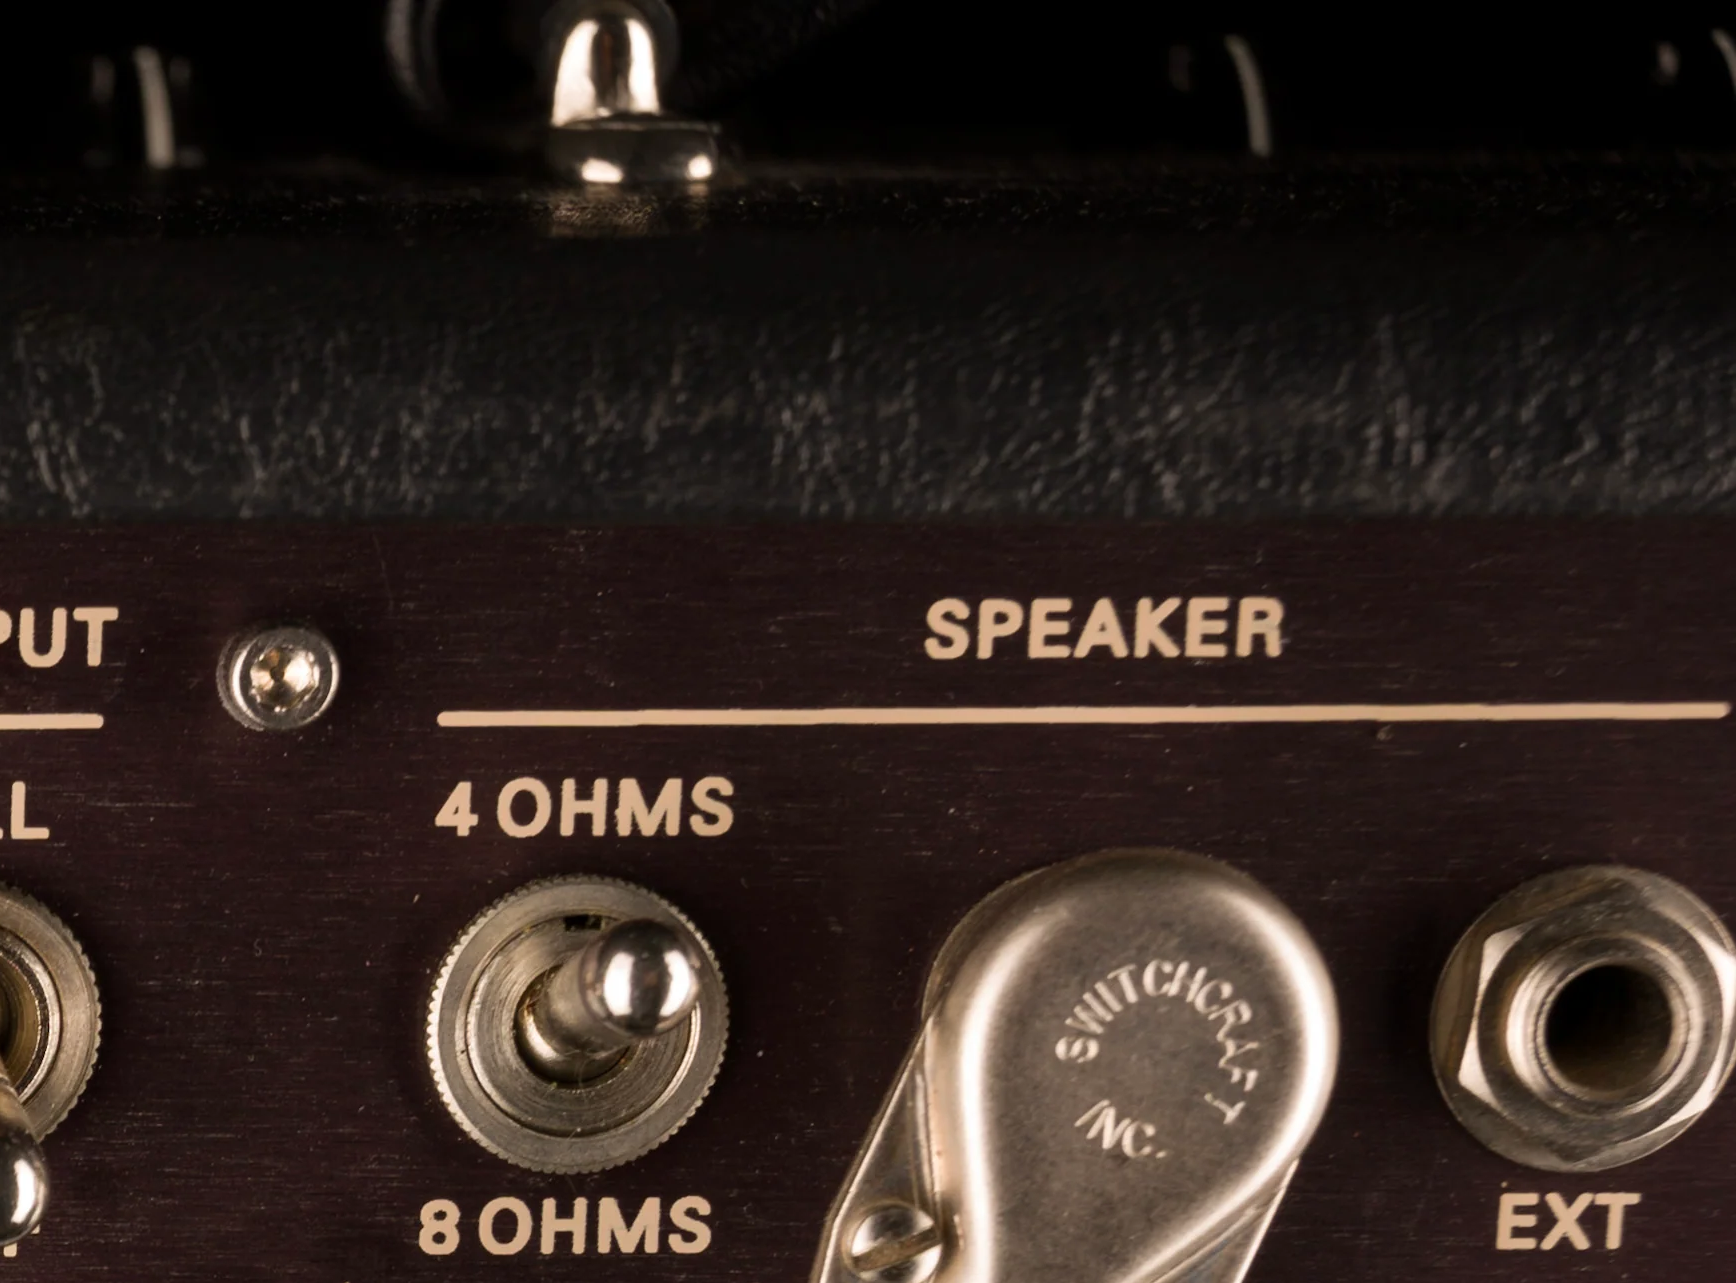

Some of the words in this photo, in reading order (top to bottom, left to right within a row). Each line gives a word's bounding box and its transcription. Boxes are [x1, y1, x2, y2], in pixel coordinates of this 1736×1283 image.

[925, 598, 1283, 659] SPEAKER
[435, 782, 478, 836] 4
[497, 777, 733, 838] OHMS
[1055, 959, 1260, 1125] SWITCHCRAFT
[1074, 1099, 1168, 1159] INC.
[419, 1199, 460, 1255] 8
[479, 1196, 711, 1255] OHMS
[1497, 1193, 1640, 1250] EXT
